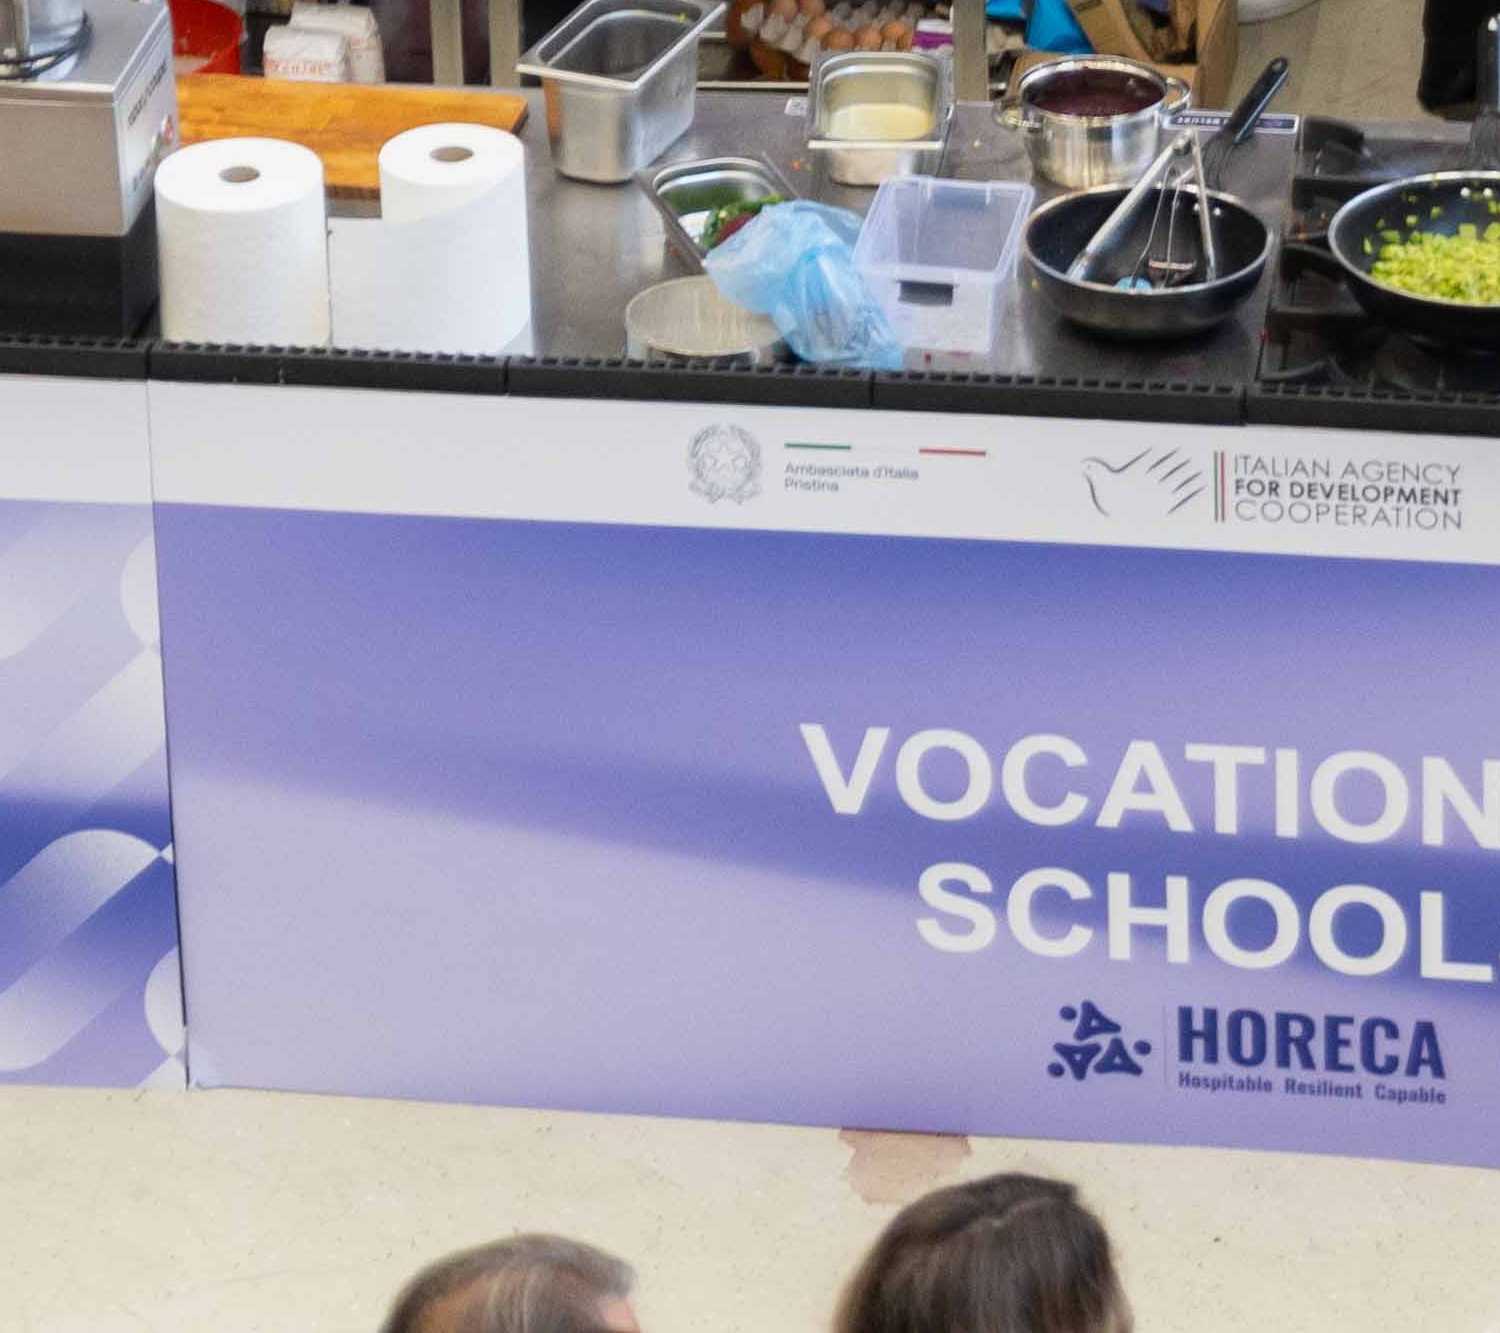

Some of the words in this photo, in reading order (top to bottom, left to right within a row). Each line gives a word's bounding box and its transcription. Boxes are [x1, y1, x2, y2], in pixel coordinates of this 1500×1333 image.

[1233, 454, 1331, 478] ITALIAN
[1340, 459, 1462, 486] AGENCY
[1234, 479, 1280, 498] FOR
[1289, 480, 1462, 506] DEVELOPMENT
[1233, 499, 1462, 530] COOPERATION
[1177, 1006, 1446, 1079] HORECA
[1178, 1071, 1273, 1094] Hospitable
[1284, 1077, 1363, 1100] Resilient
[1374, 1083, 1447, 1105] Capable
